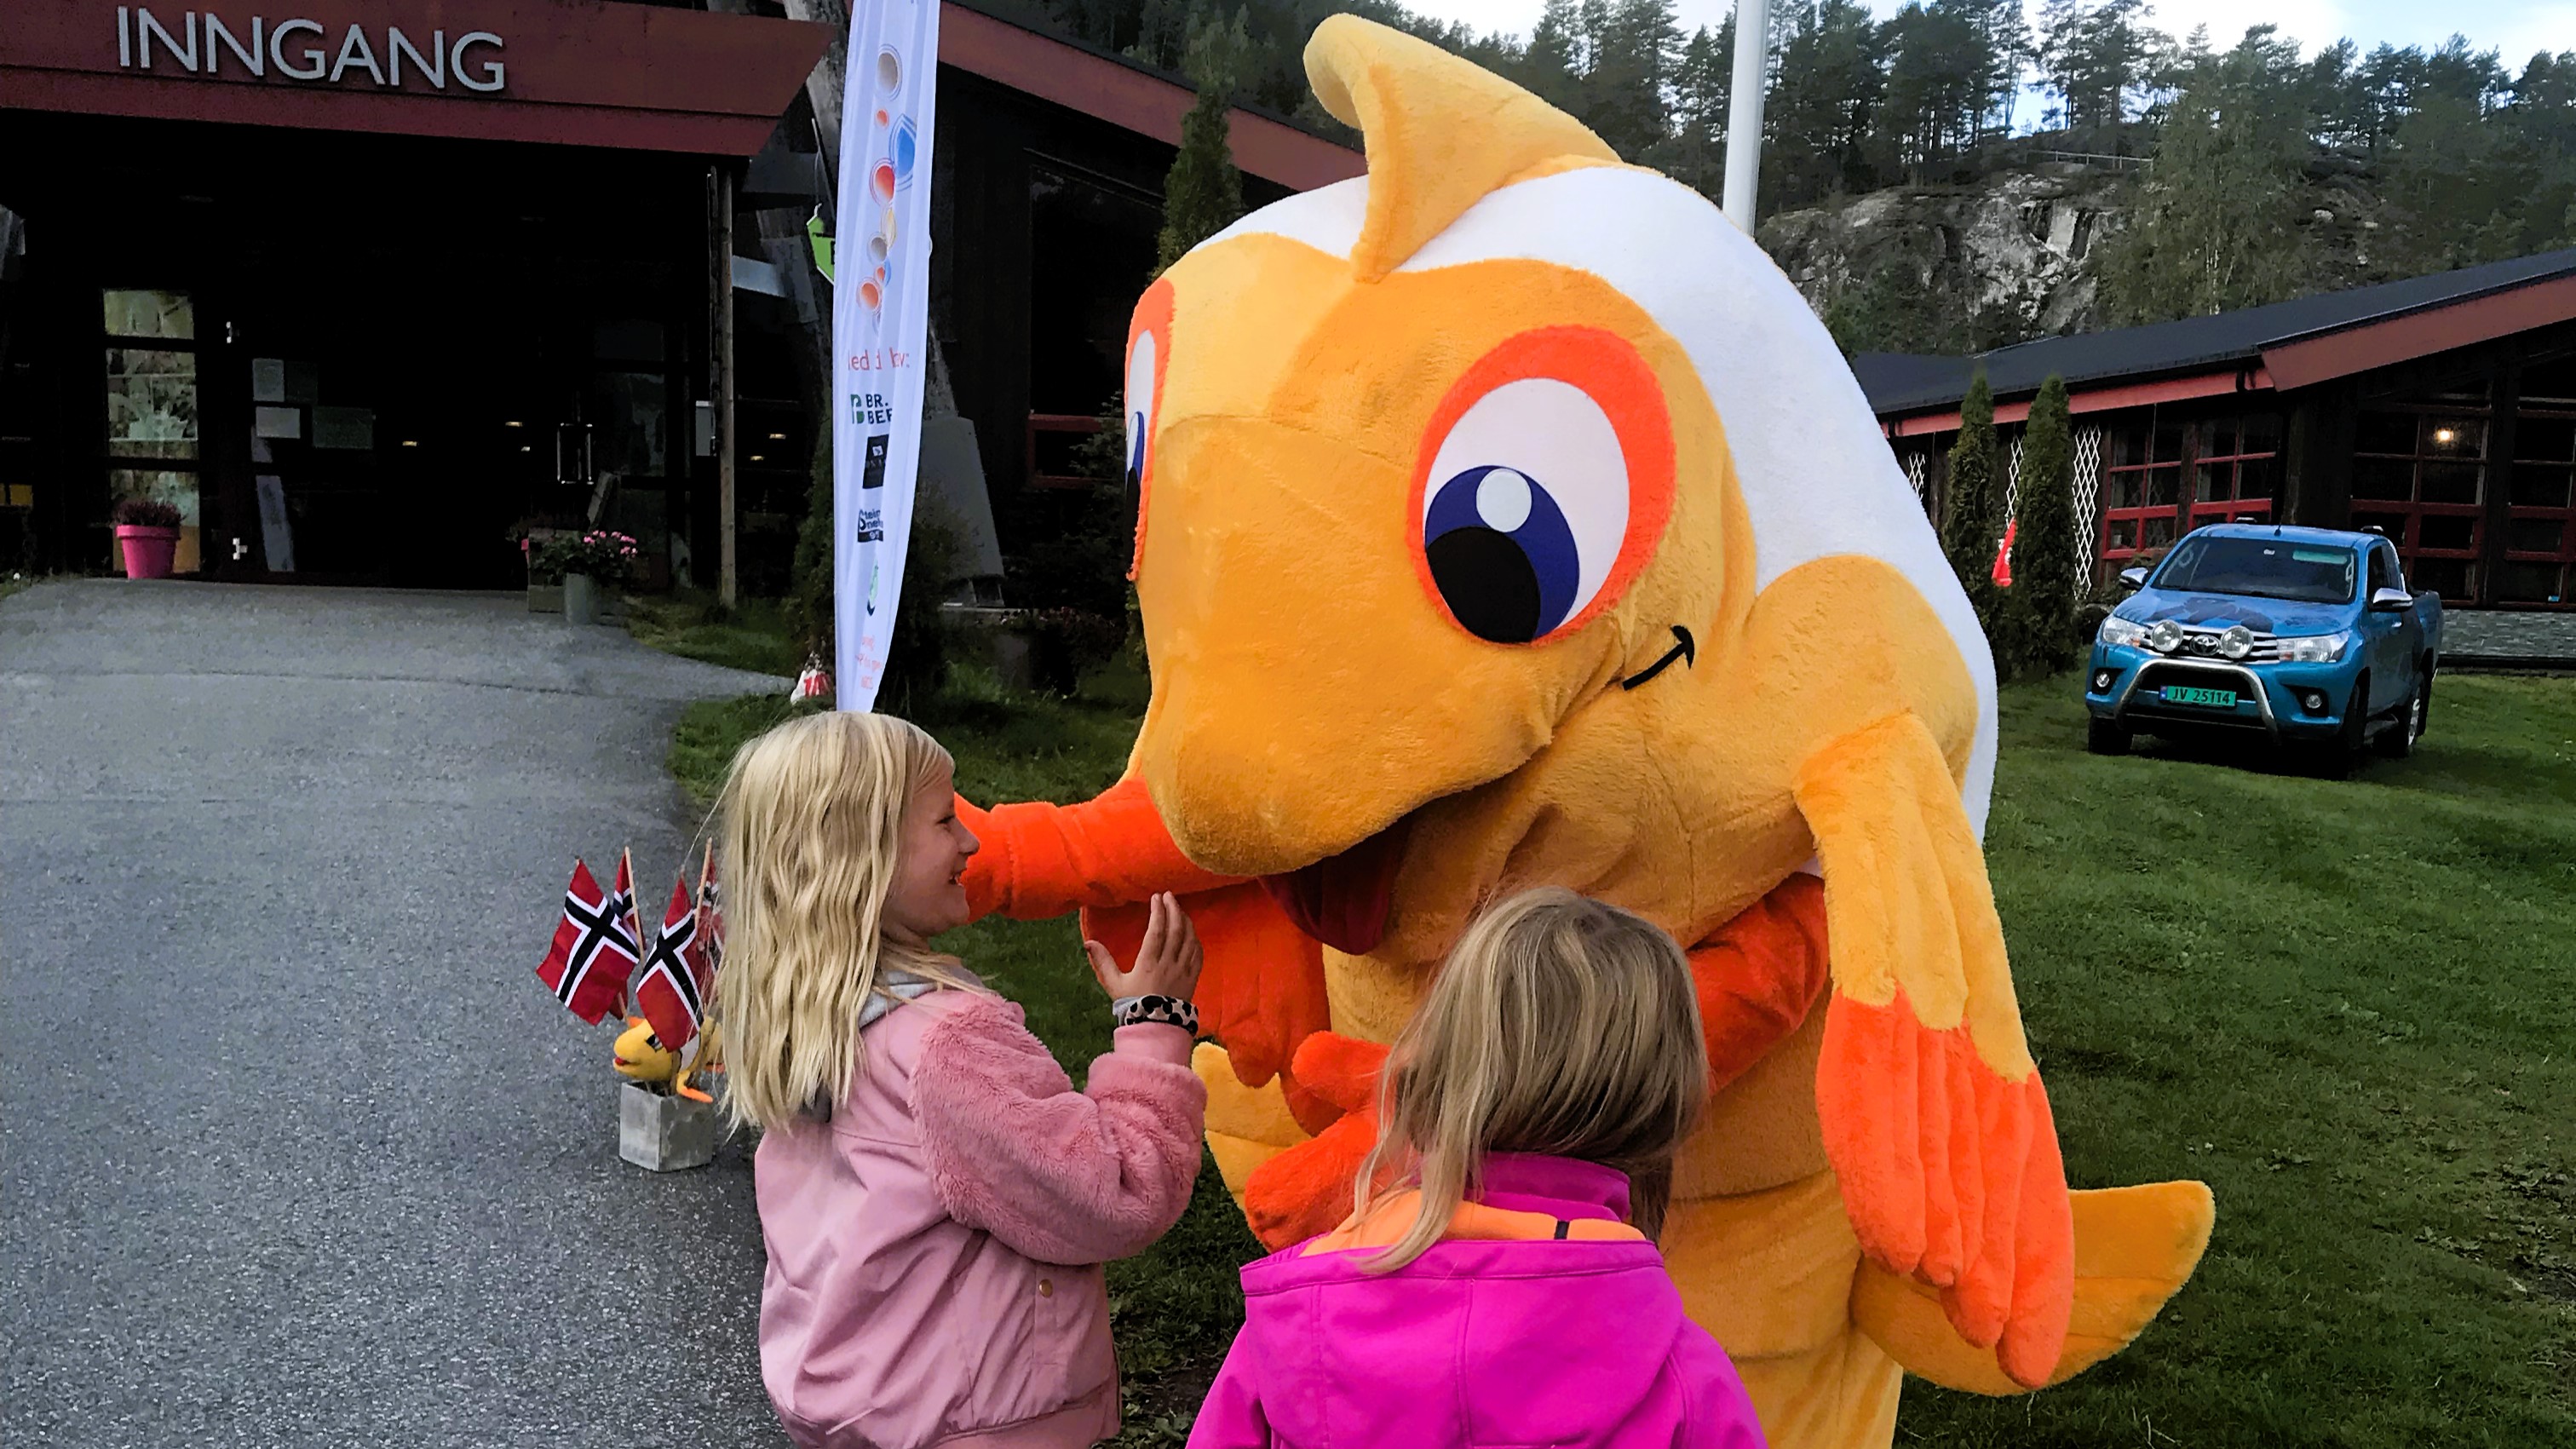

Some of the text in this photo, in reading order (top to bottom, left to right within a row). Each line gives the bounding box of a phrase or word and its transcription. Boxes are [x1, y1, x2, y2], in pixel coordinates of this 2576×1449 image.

[118, 5, 505, 92] INNGANG
[2172, 687, 2230, 704] JV 25114
